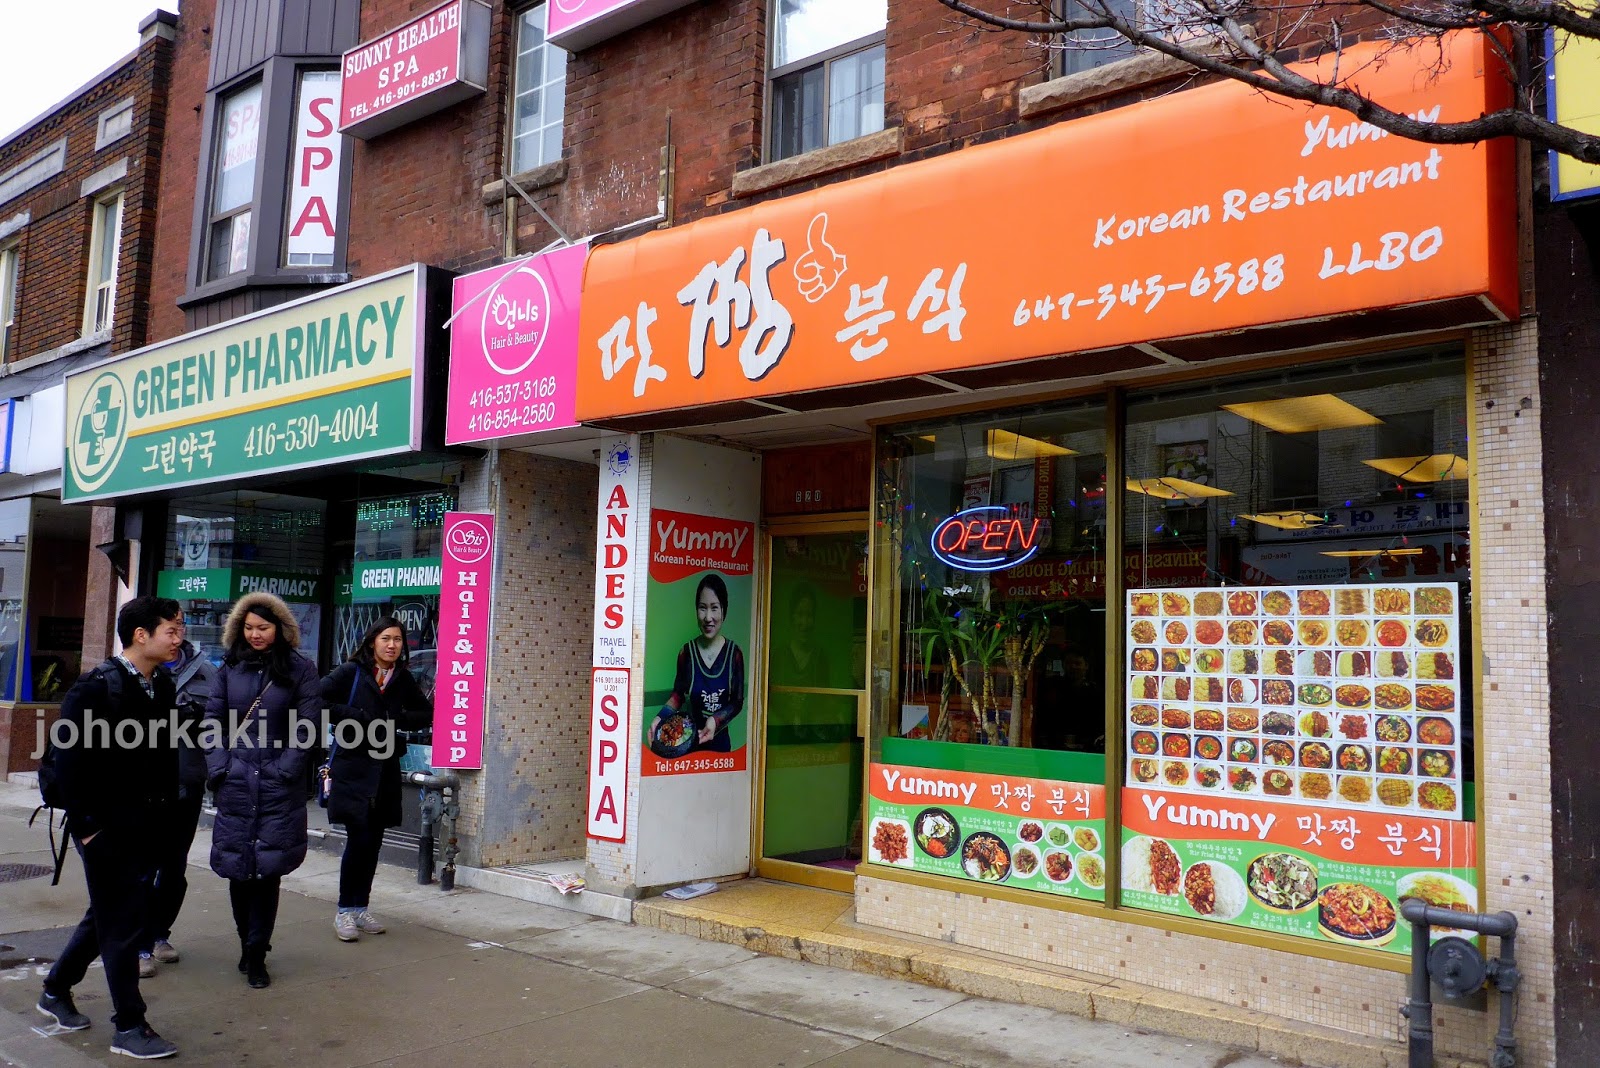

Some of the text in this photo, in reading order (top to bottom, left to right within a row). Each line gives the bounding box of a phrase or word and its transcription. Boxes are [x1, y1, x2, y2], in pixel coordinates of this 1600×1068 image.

[346, 4, 459, 78] SUNNY HEALTH
[378, 55, 419, 89] SPA
[1301, 104, 1431, 157] Yumy
[290, 98, 335, 237] SPA
[1092, 148, 1443, 249] Korean Restaurant
[1013, 226, 1443, 328] 647-345-6588 LLBO
[835, 262, 968, 362] 분식
[133, 295, 405, 419] GREEN PHARMACY
[491, 330, 539, 350] Hair & Beauty
[469, 376, 556, 408] 416-537-3168
[244, 402, 379, 459] 416-530-4004
[468, 402, 555, 432] 416-854-2580
[142, 430, 216, 475] 그린약국
[656, 519, 749, 558] Yummy
[939, 518, 1040, 551] OPEN
[361, 565, 442, 588] GREEN PHARMA
[603, 484, 629, 630] ANDES
[654, 552, 749, 572] Korean Food Restaurant
[178, 576, 208, 592] 그린약국
[239, 575, 317, 597] PHARMACY
[599, 637, 627, 647] TRAVEL
[600, 656, 626, 666] TOURS
[609, 647, 615, 656] &
[594, 695, 619, 824] SPA
[655, 757, 735, 773] Tel: 647-345-6588
[882, 768, 1091, 819] Yummy 맛짱 분식
[1141, 793, 1276, 840] Yummy
[1296, 812, 1362, 851] 맛짱
[1377, 822, 1443, 862] 분식
